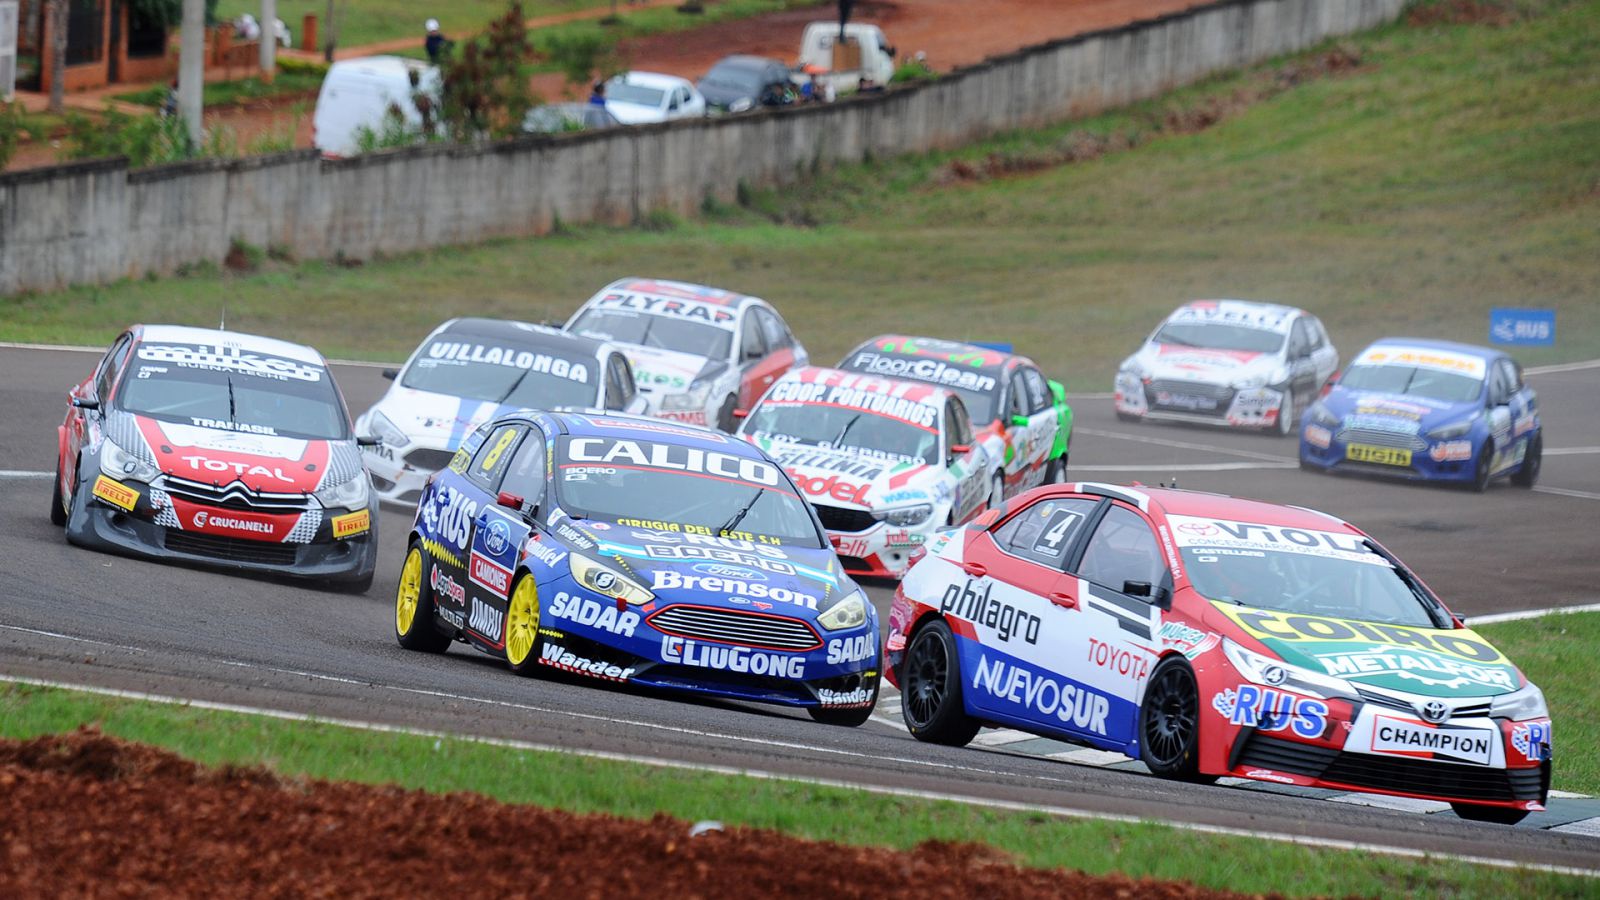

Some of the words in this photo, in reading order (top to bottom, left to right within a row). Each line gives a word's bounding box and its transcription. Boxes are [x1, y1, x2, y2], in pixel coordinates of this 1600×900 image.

[599, 294, 735, 323] PLYRAP
[238, 368, 289, 381] LECHE
[429, 341, 588, 383] VILLALONGA
[853, 352, 996, 391] FloorClean
[828, 385, 937, 428] PORTUARIOS
[482, 429, 517, 470] 8
[569, 438, 778, 486] CALICO
[181, 456, 295, 483] TOTAL
[565, 467, 616, 476] BOERO
[209, 516, 274, 533] CRUCIANELLI
[437, 486, 478, 550] RUS
[684, 524, 713, 536] DEL
[1044, 514, 1077, 548] 4
[597, 574, 614, 588] 8
[650, 570, 820, 611] Brenson
[549, 591, 640, 638] SADAR
[941, 578, 1041, 645] philagro
[1237, 611, 1501, 662] COIRO
[542, 642, 636, 680] Wander
[1088, 638, 1148, 681] TOYOTA
[1266, 668, 1284, 684] 4
[1319, 651, 1515, 692] METALFOR
[818, 687, 874, 704] Wander
[1230, 684, 1330, 740] RUS
[1379, 726, 1488, 754] CHAMPION
